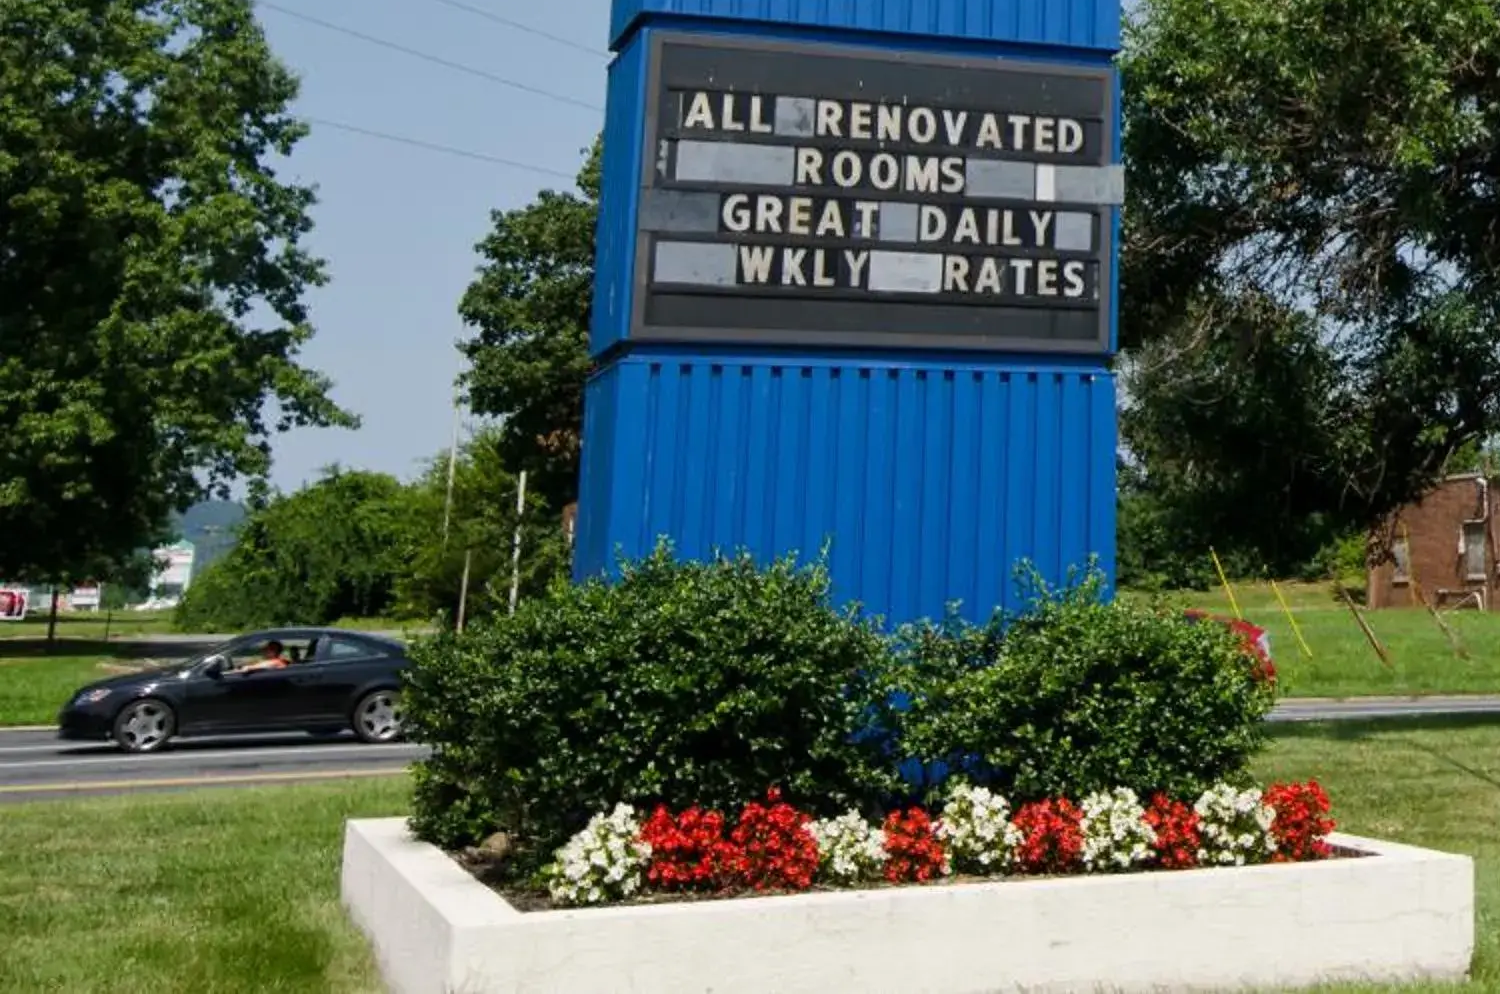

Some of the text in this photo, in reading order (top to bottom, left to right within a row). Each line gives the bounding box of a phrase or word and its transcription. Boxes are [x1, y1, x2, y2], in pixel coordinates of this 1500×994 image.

[684, 92, 1083, 153] ALL RENOVATED
[797, 149, 964, 193] ROOMS
[723, 195, 1054, 246] GREAT DAILY
[739, 246, 1084, 297] WKLY RATES
